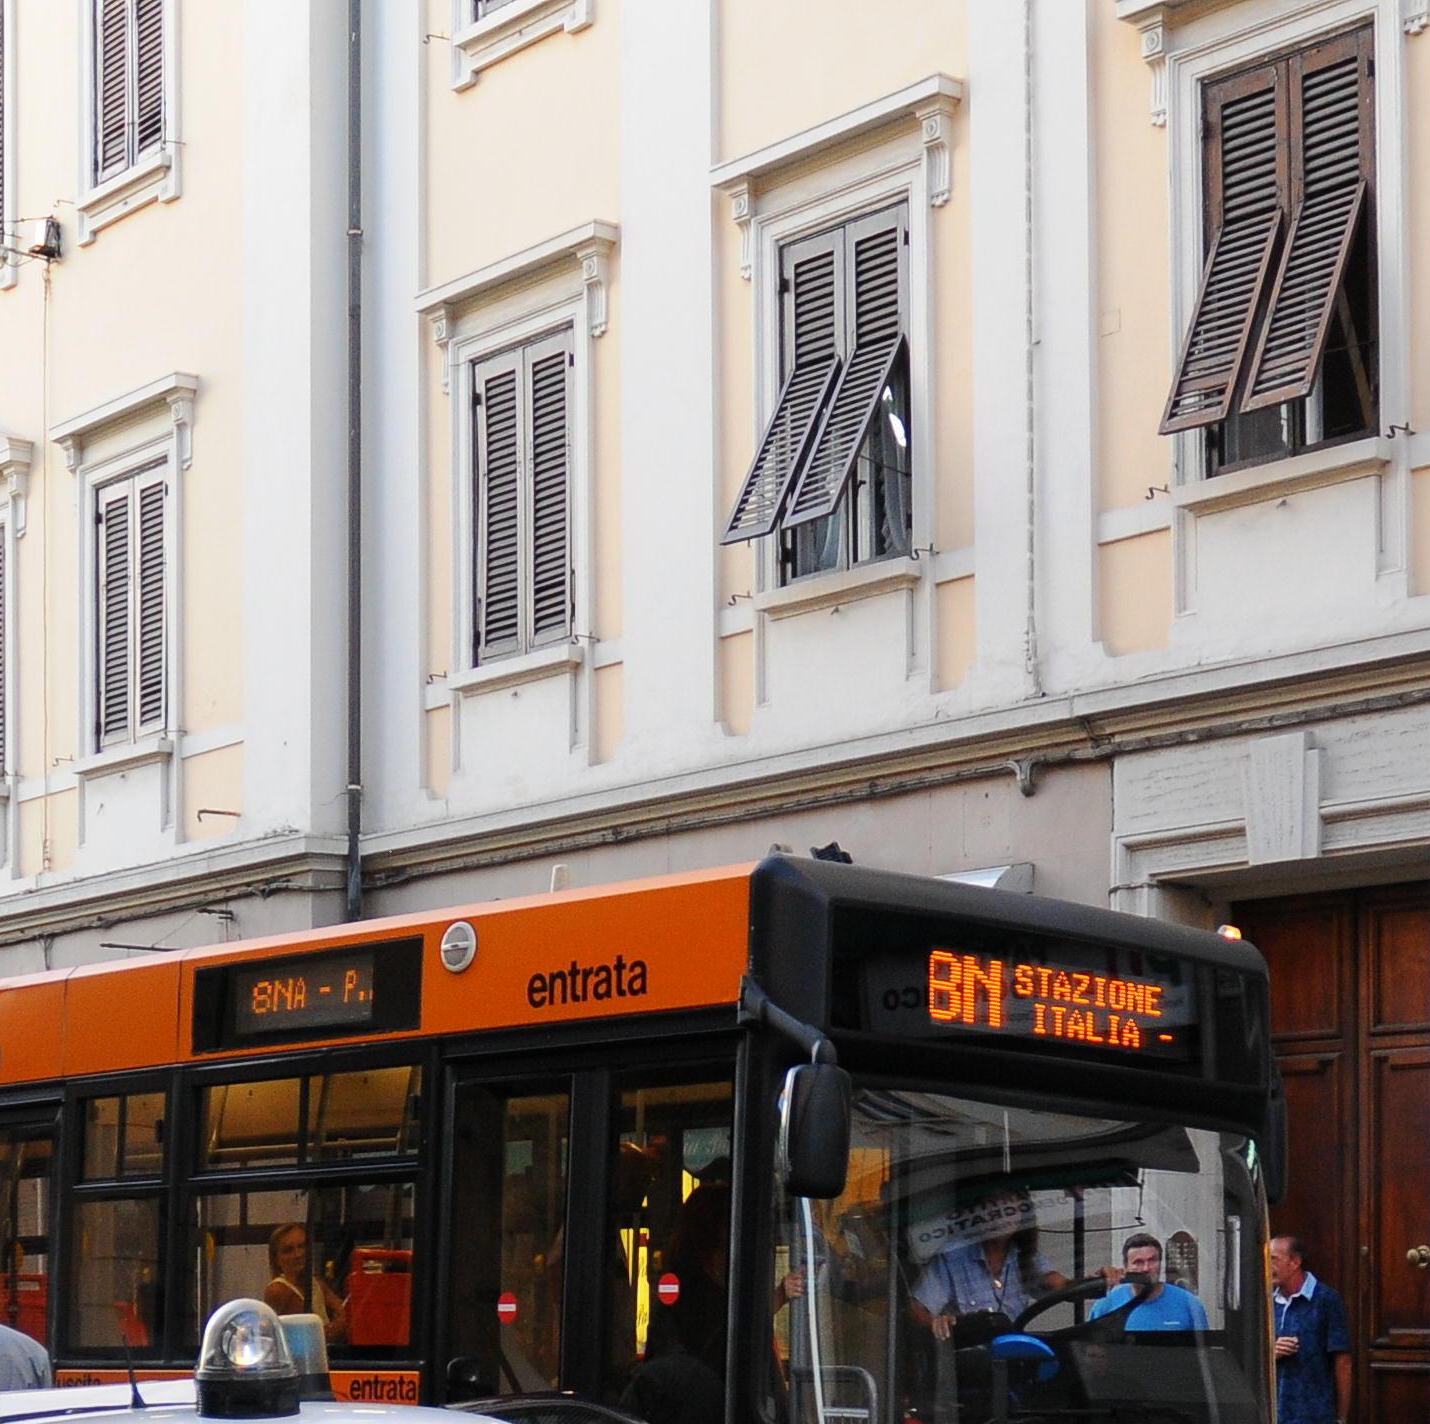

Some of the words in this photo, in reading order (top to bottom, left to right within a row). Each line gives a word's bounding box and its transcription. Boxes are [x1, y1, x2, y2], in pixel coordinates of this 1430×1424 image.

[526, 953, 648, 1009] entrata
[1013, 963, 1163, 1017] STAZIONE
[1033, 1002, 1141, 1048] ITALIA
[349, 1374, 417, 1401] entrata
